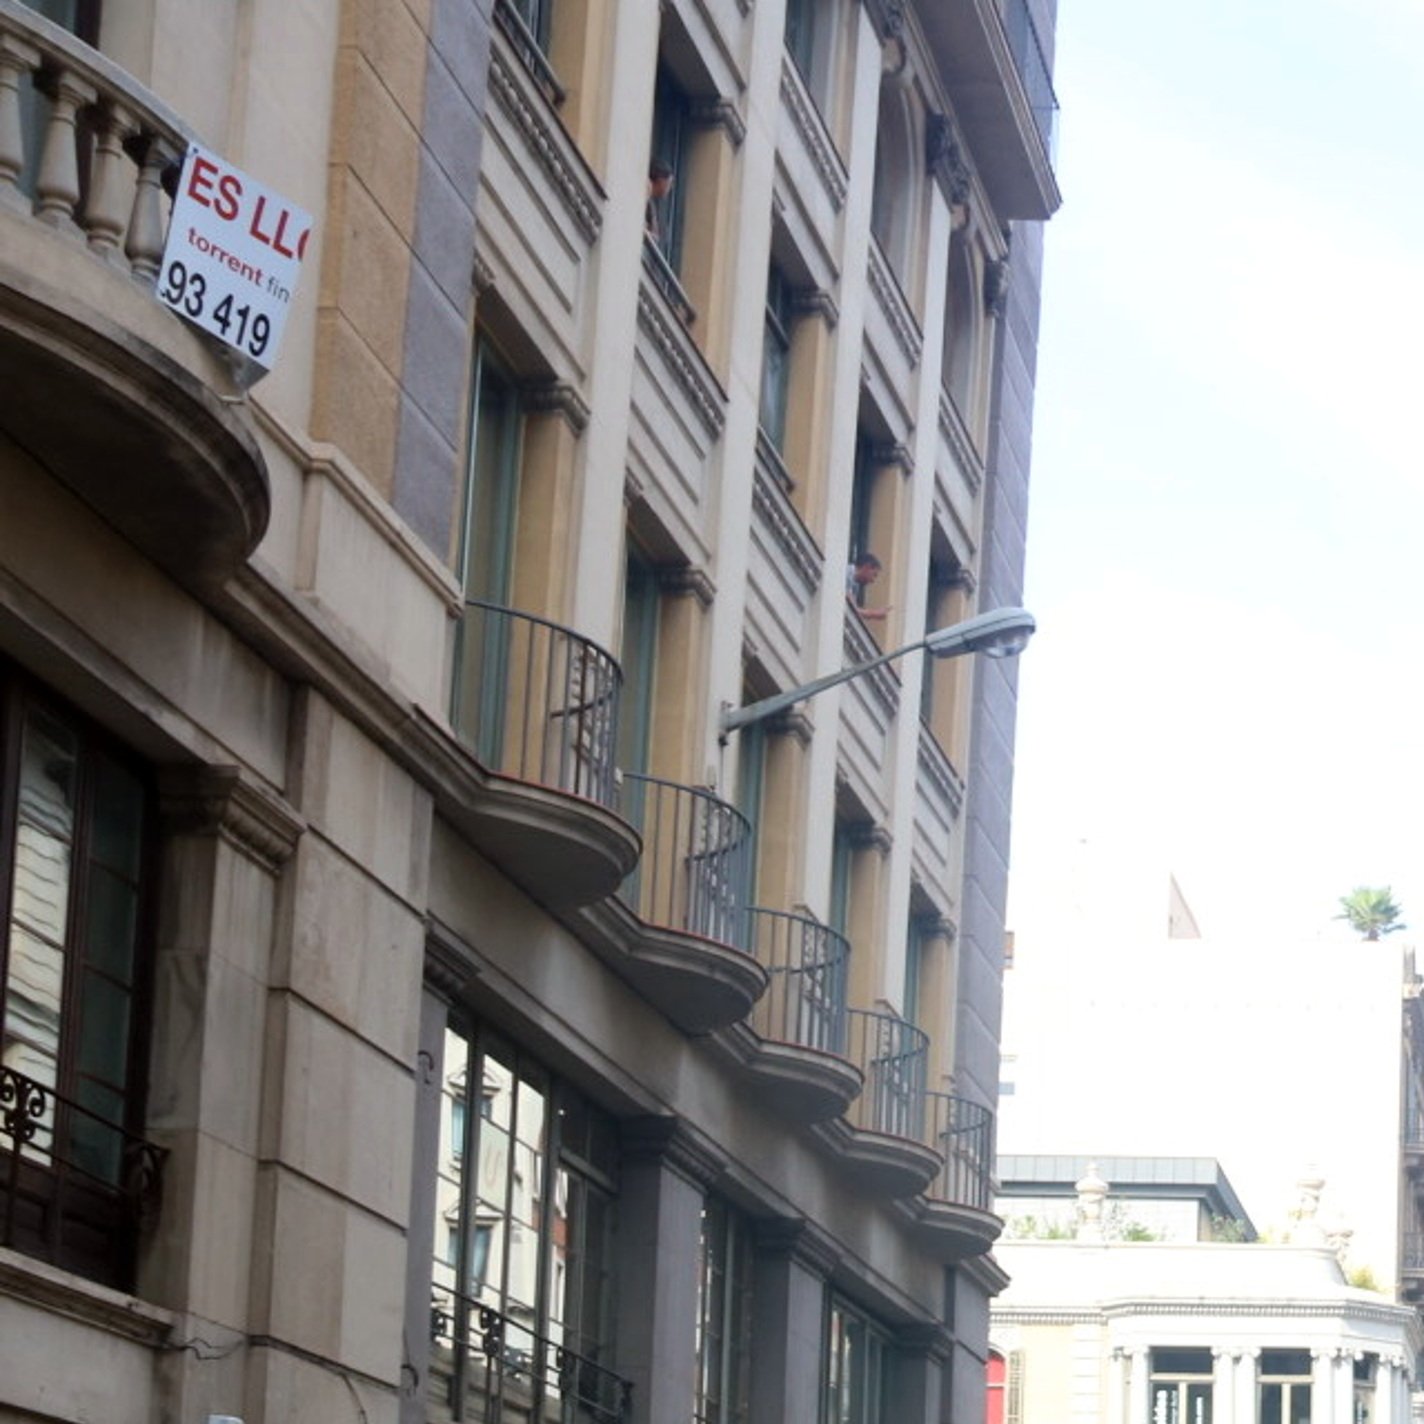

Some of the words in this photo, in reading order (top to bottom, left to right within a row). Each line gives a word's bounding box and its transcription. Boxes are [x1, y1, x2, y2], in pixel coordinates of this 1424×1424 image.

[187, 156, 242, 221] ES
[188, 228, 264, 287] torrent
[267, 276, 291, 303] fin
[166, 261, 207, 317] 93
[213, 294, 270, 357] 419
